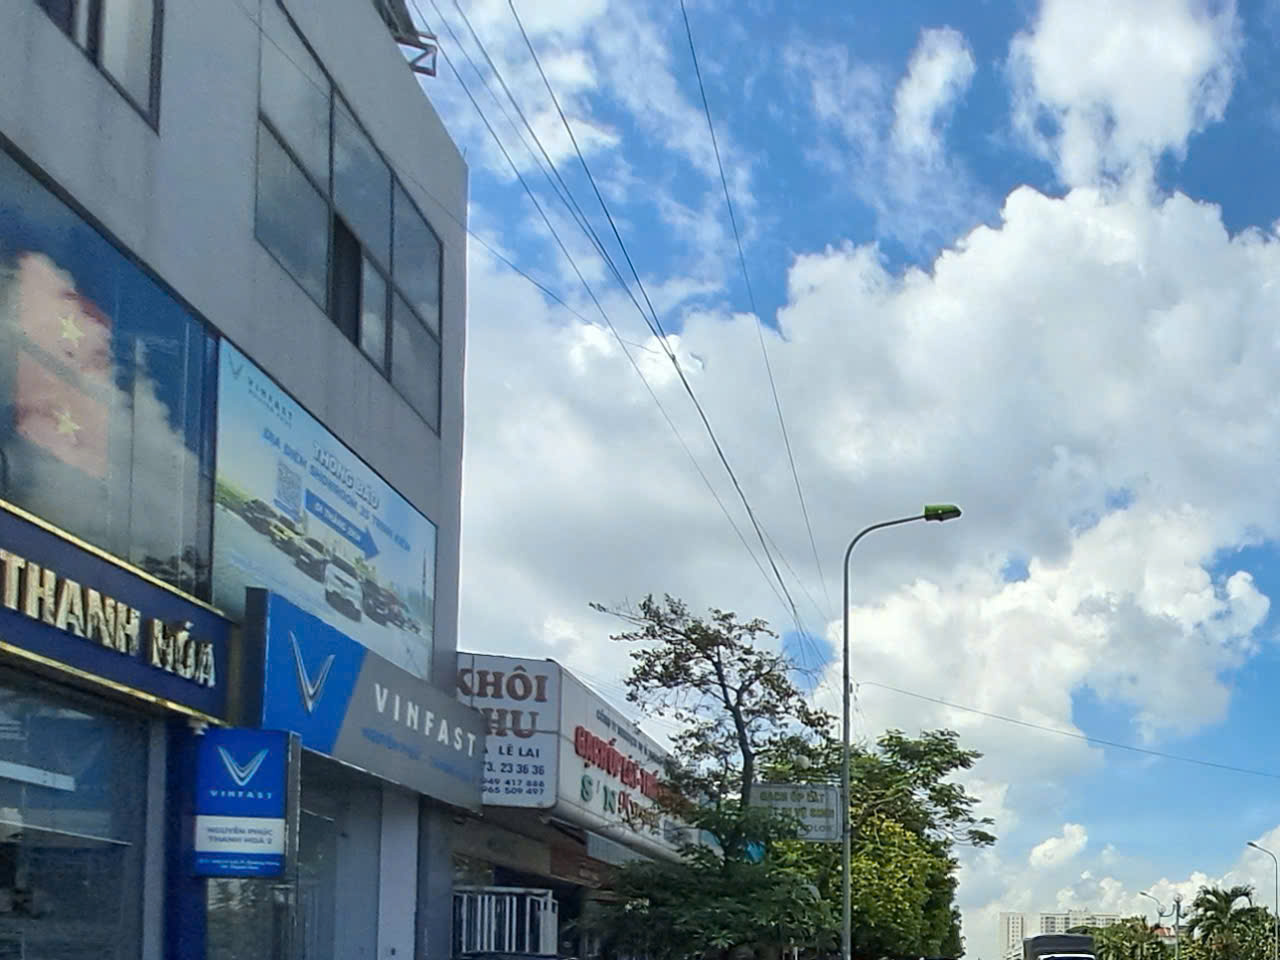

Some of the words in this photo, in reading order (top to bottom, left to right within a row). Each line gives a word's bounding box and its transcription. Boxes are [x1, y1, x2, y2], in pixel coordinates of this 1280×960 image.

[0, 547, 141, 658] THANH
[152, 617, 217, 689] HÓA
[375, 682, 476, 758] VINFAST
[518, 746, 540, 758] LAI
[500, 762, 514, 773] 23
[516, 763, 530, 774] 36
[531, 764, 545, 776] 36
[209, 790, 273, 799] VINFAST
